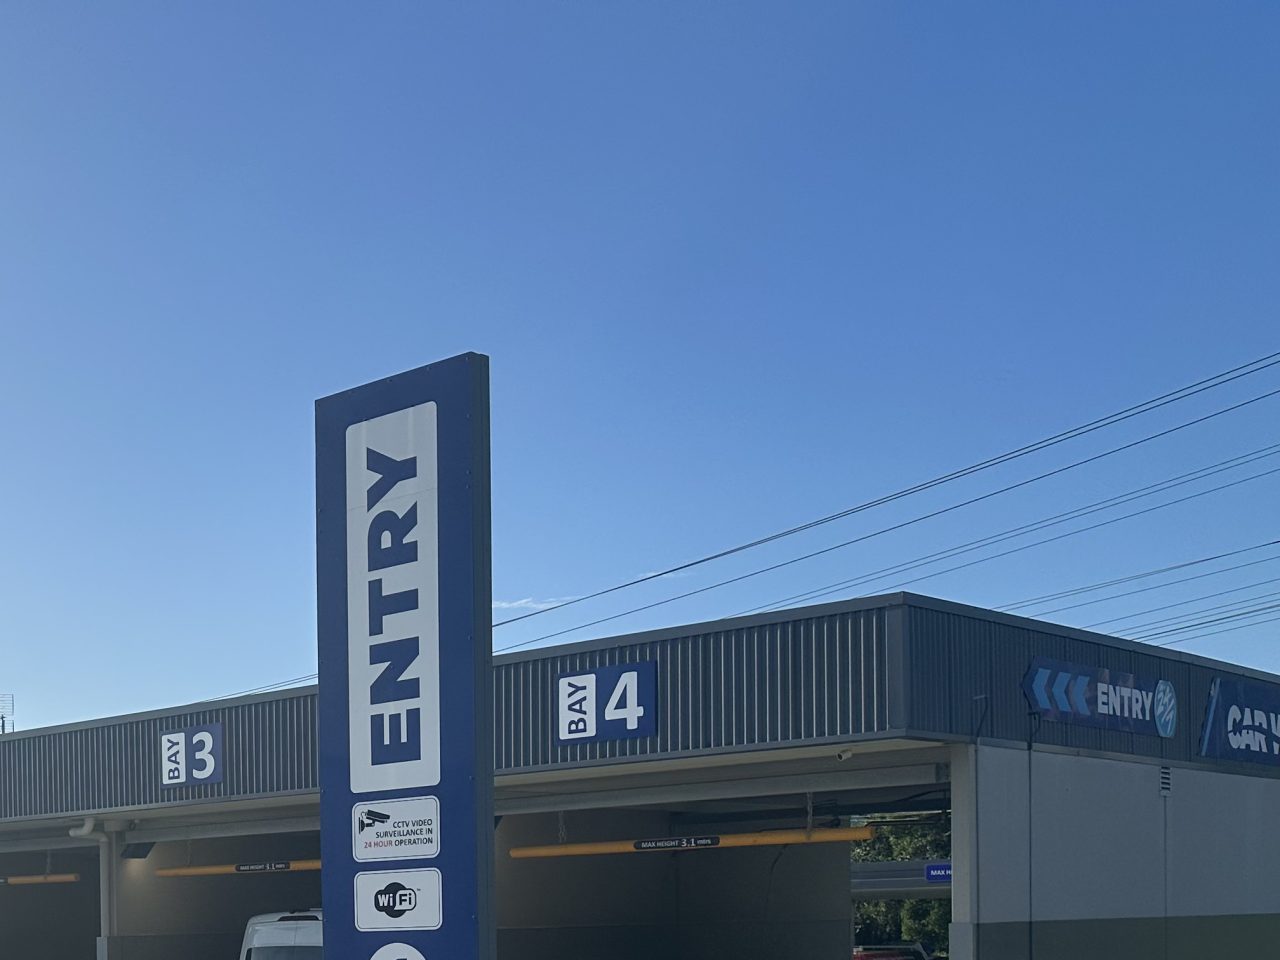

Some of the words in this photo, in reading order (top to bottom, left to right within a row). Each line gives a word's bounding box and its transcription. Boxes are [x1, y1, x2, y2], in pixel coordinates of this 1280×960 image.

[366, 447, 422, 766] ENTRY
[567, 681, 587, 735] BAY
[604, 670, 644, 730] 4
[1096, 682, 1154, 721] ENTRY
[1227, 704, 1268, 754] CAR
[167, 738, 181, 781] BAY
[192, 731, 216, 779] 3
[363, 841, 372, 849] 24
[373, 840, 393, 848] HOUR
[394, 837, 434, 847] OPERATION
[375, 828, 424, 839] SURVEILLANCE
[425, 827, 433, 836] IN
[392, 820, 410, 829] CCTV
[411, 818, 433, 828] VIDEO
[681, 838, 696, 847] 3.1
